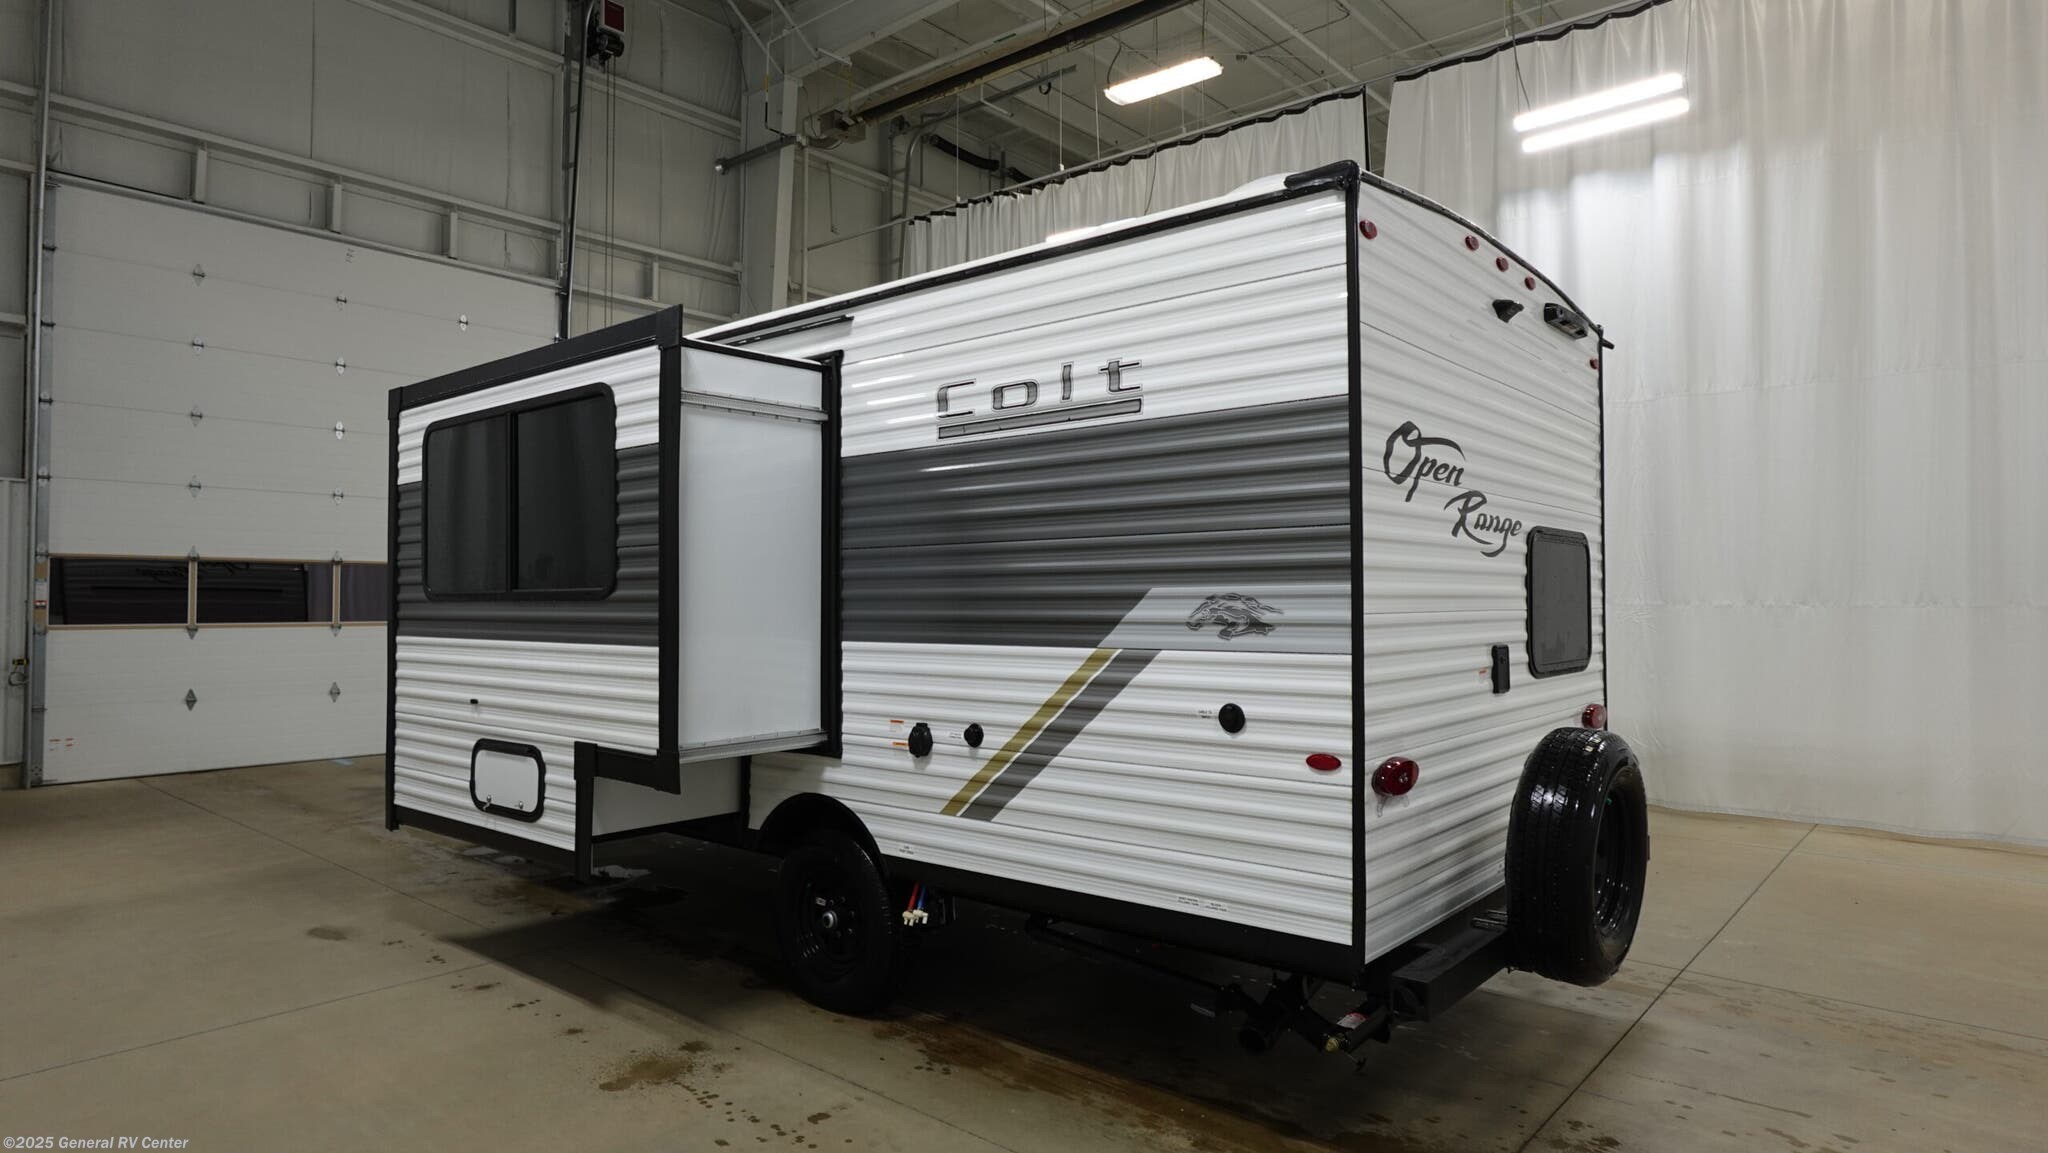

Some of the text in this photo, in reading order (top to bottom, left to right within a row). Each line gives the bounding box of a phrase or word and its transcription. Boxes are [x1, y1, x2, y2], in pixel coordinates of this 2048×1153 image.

[937, 359, 1141, 419] Colt
[1383, 421, 1465, 502] Open
[1444, 490, 1522, 557] Range
